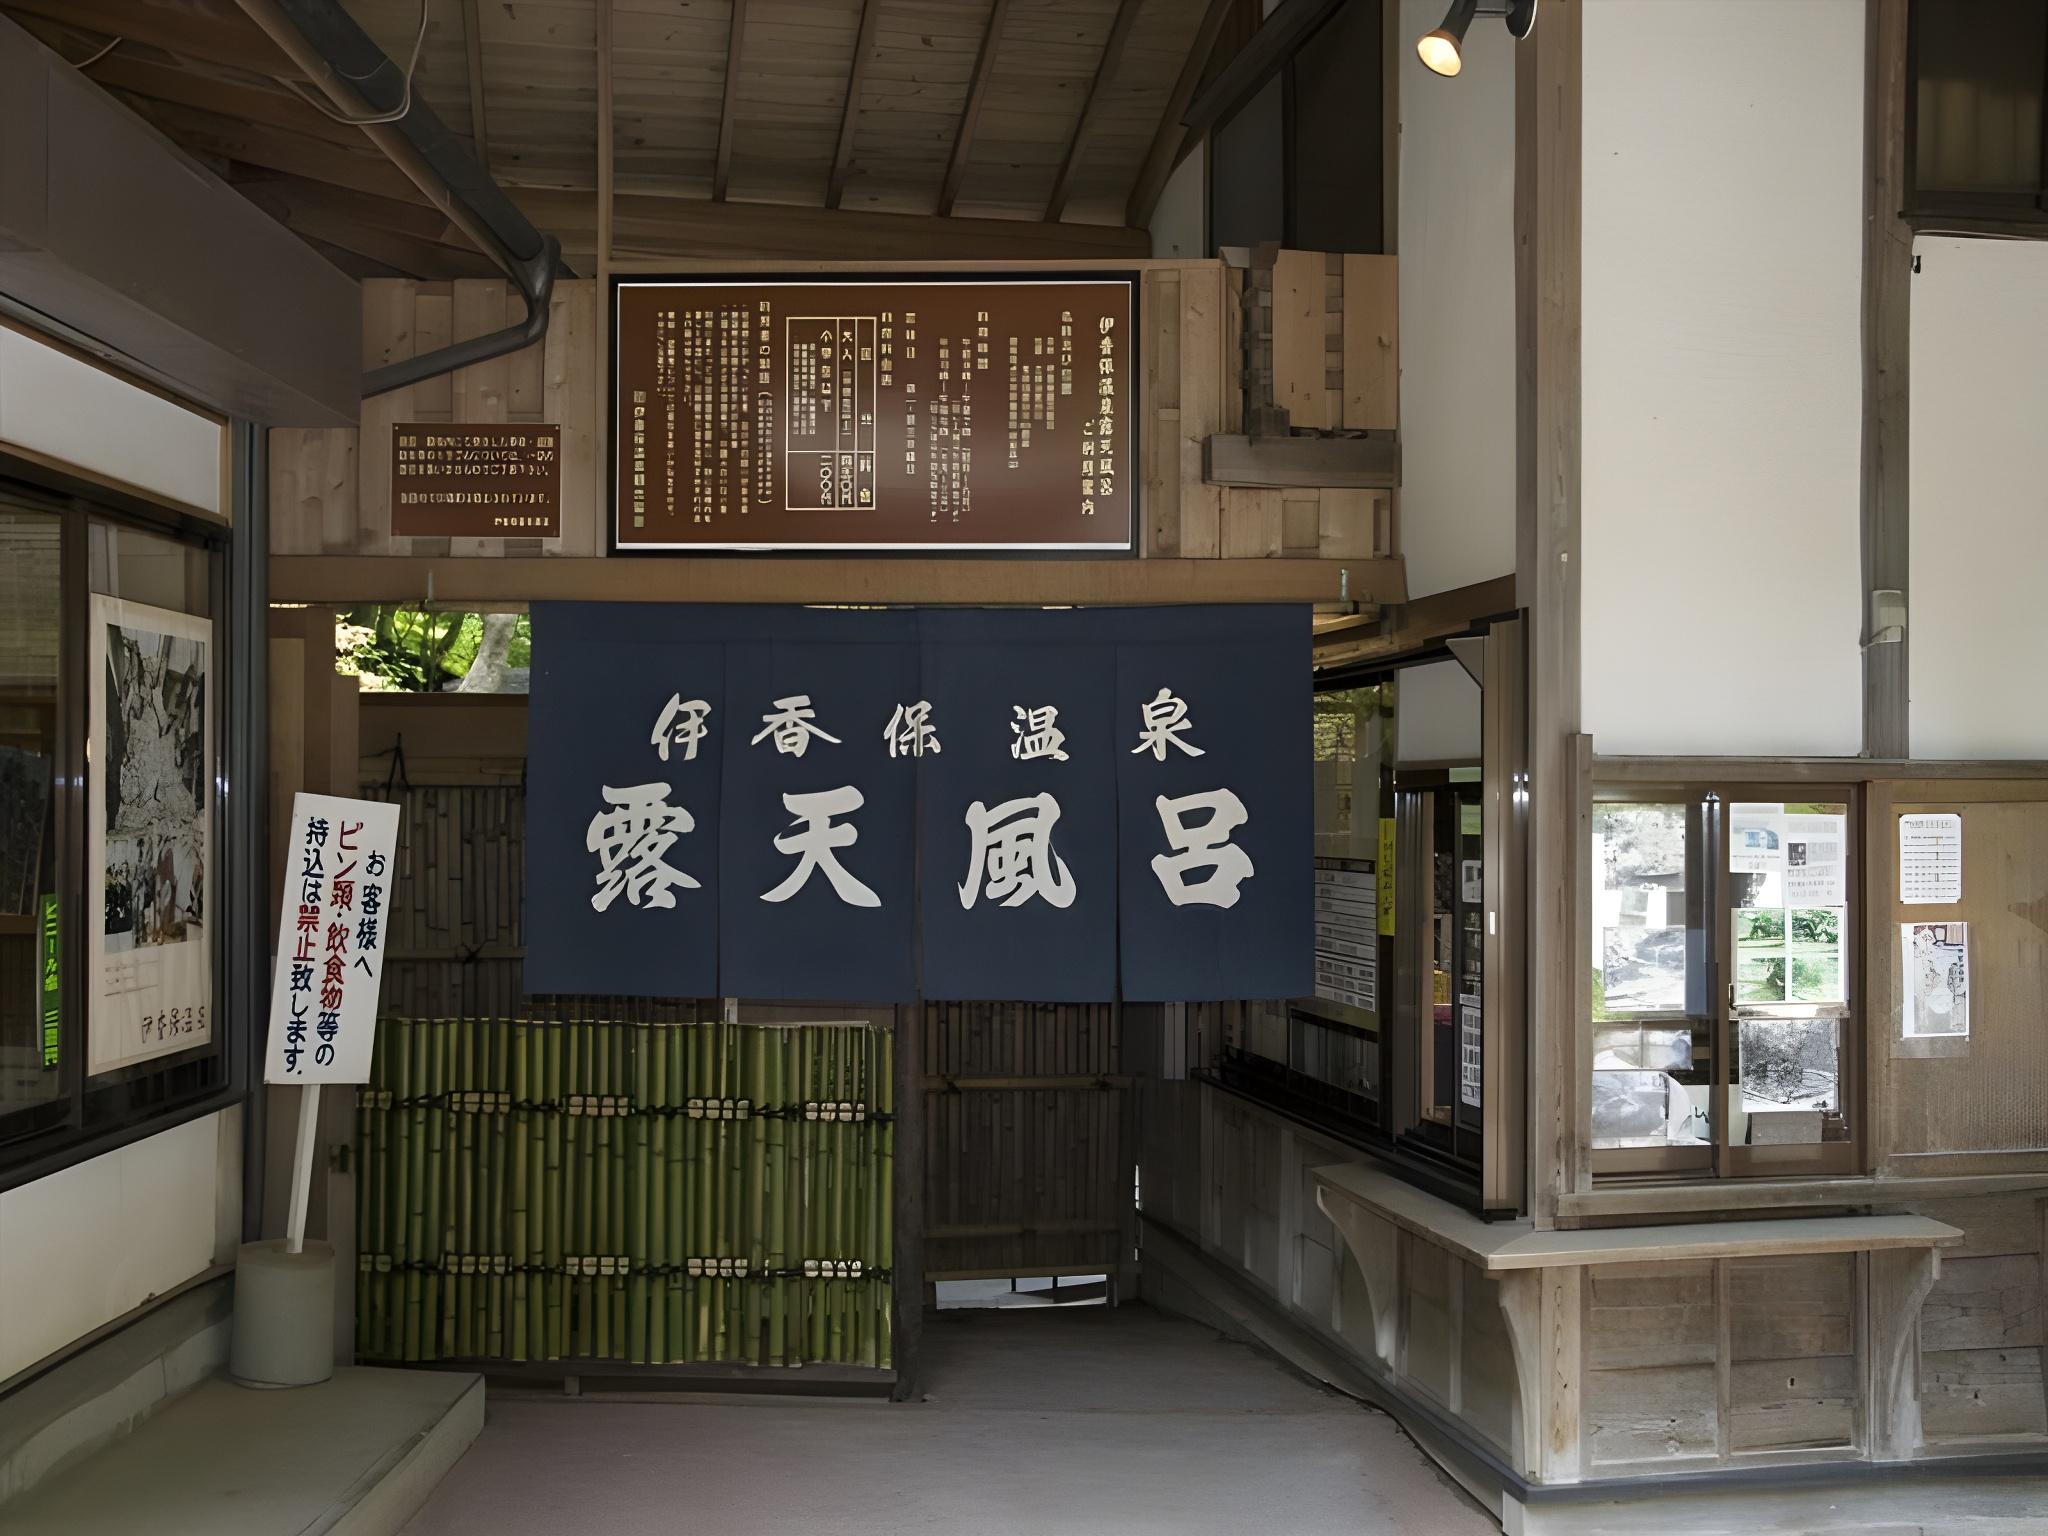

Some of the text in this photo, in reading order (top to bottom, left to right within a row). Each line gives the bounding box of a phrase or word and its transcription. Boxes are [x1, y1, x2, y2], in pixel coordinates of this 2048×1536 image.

[650, 687, 1206, 762] 伊香保温泉
[586, 783, 1256, 913] 露天風呂
[353, 850, 386, 978] お客様へ
